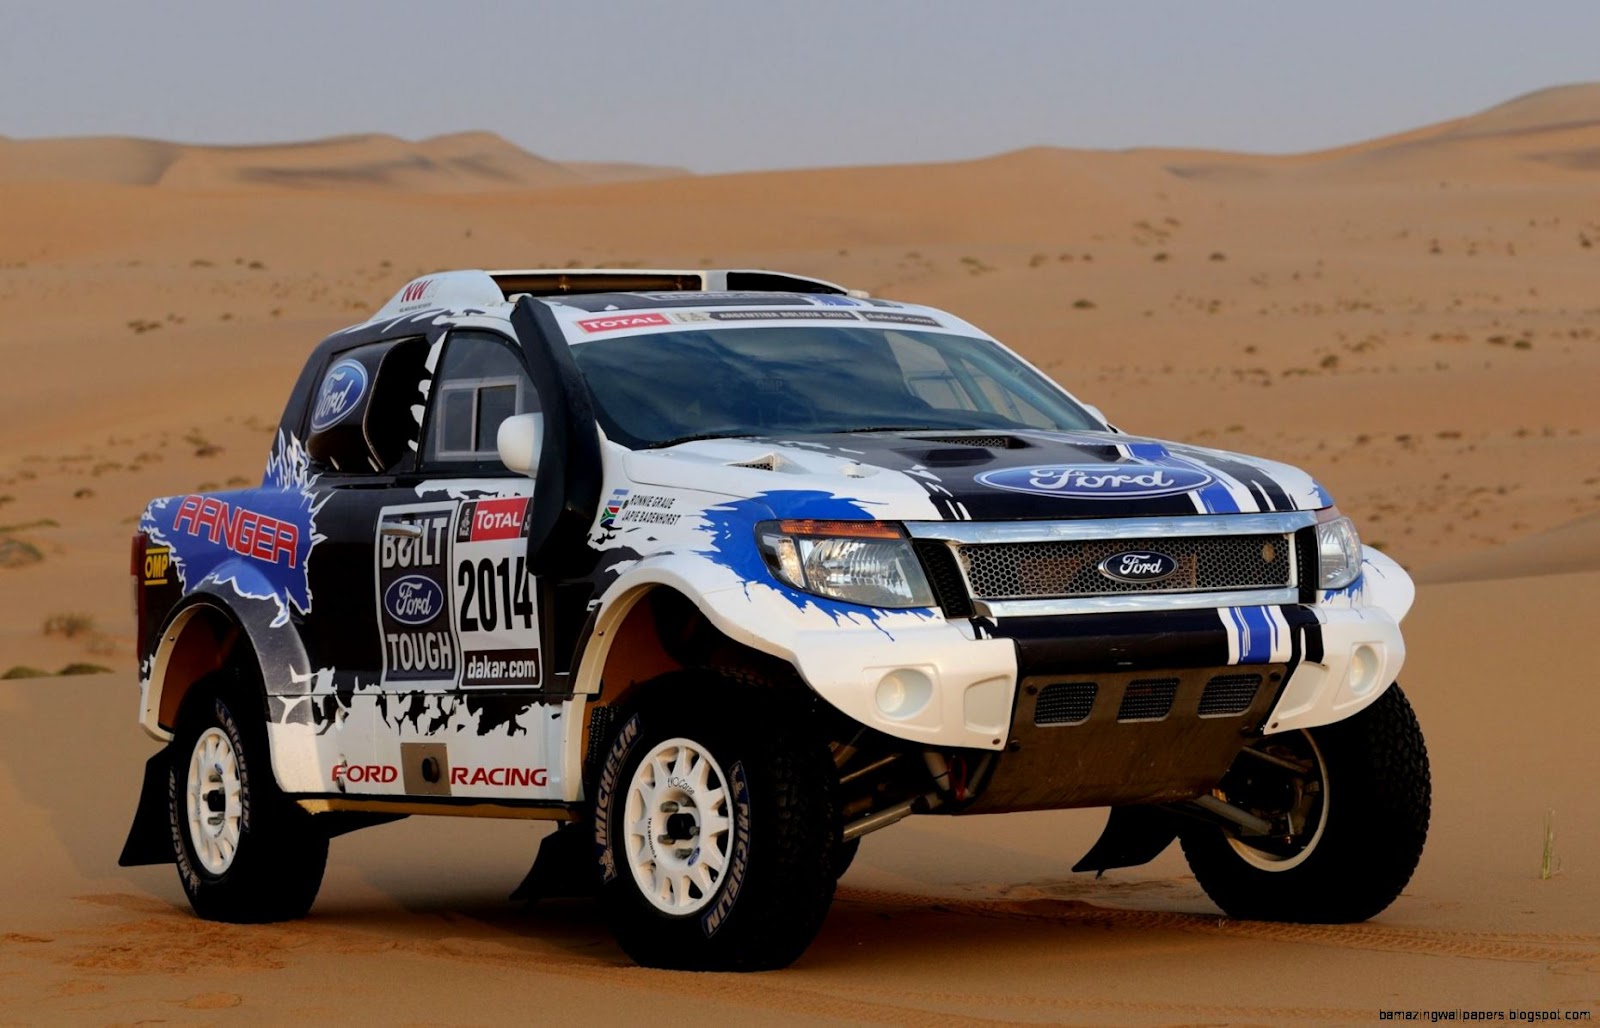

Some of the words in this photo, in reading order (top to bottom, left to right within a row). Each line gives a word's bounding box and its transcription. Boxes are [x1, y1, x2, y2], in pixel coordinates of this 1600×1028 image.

[583, 315, 664, 330] TOTAL
[313, 370, 355, 419] Ford
[1029, 466, 1176, 491] Ford
[629, 494, 653, 507] RONNIE
[477, 509, 521, 531] TOTAL
[621, 510, 640, 523] JAPIE
[173, 494, 299, 569] RANGER
[382, 517, 448, 569] BUILT
[144, 554, 169, 578] OMP
[1119, 554, 1163, 575] Ford
[396, 581, 432, 616] Ford
[458, 556, 533, 632] 2014
[387, 632, 453, 673] TOUGH
[467, 654, 536, 680] dakar.com
[332, 765, 398, 784] FORD
[451, 766, 548, 787] RACING
[594, 717, 639, 848] MICHELIN
[706, 801, 751, 934] MICHELIN
